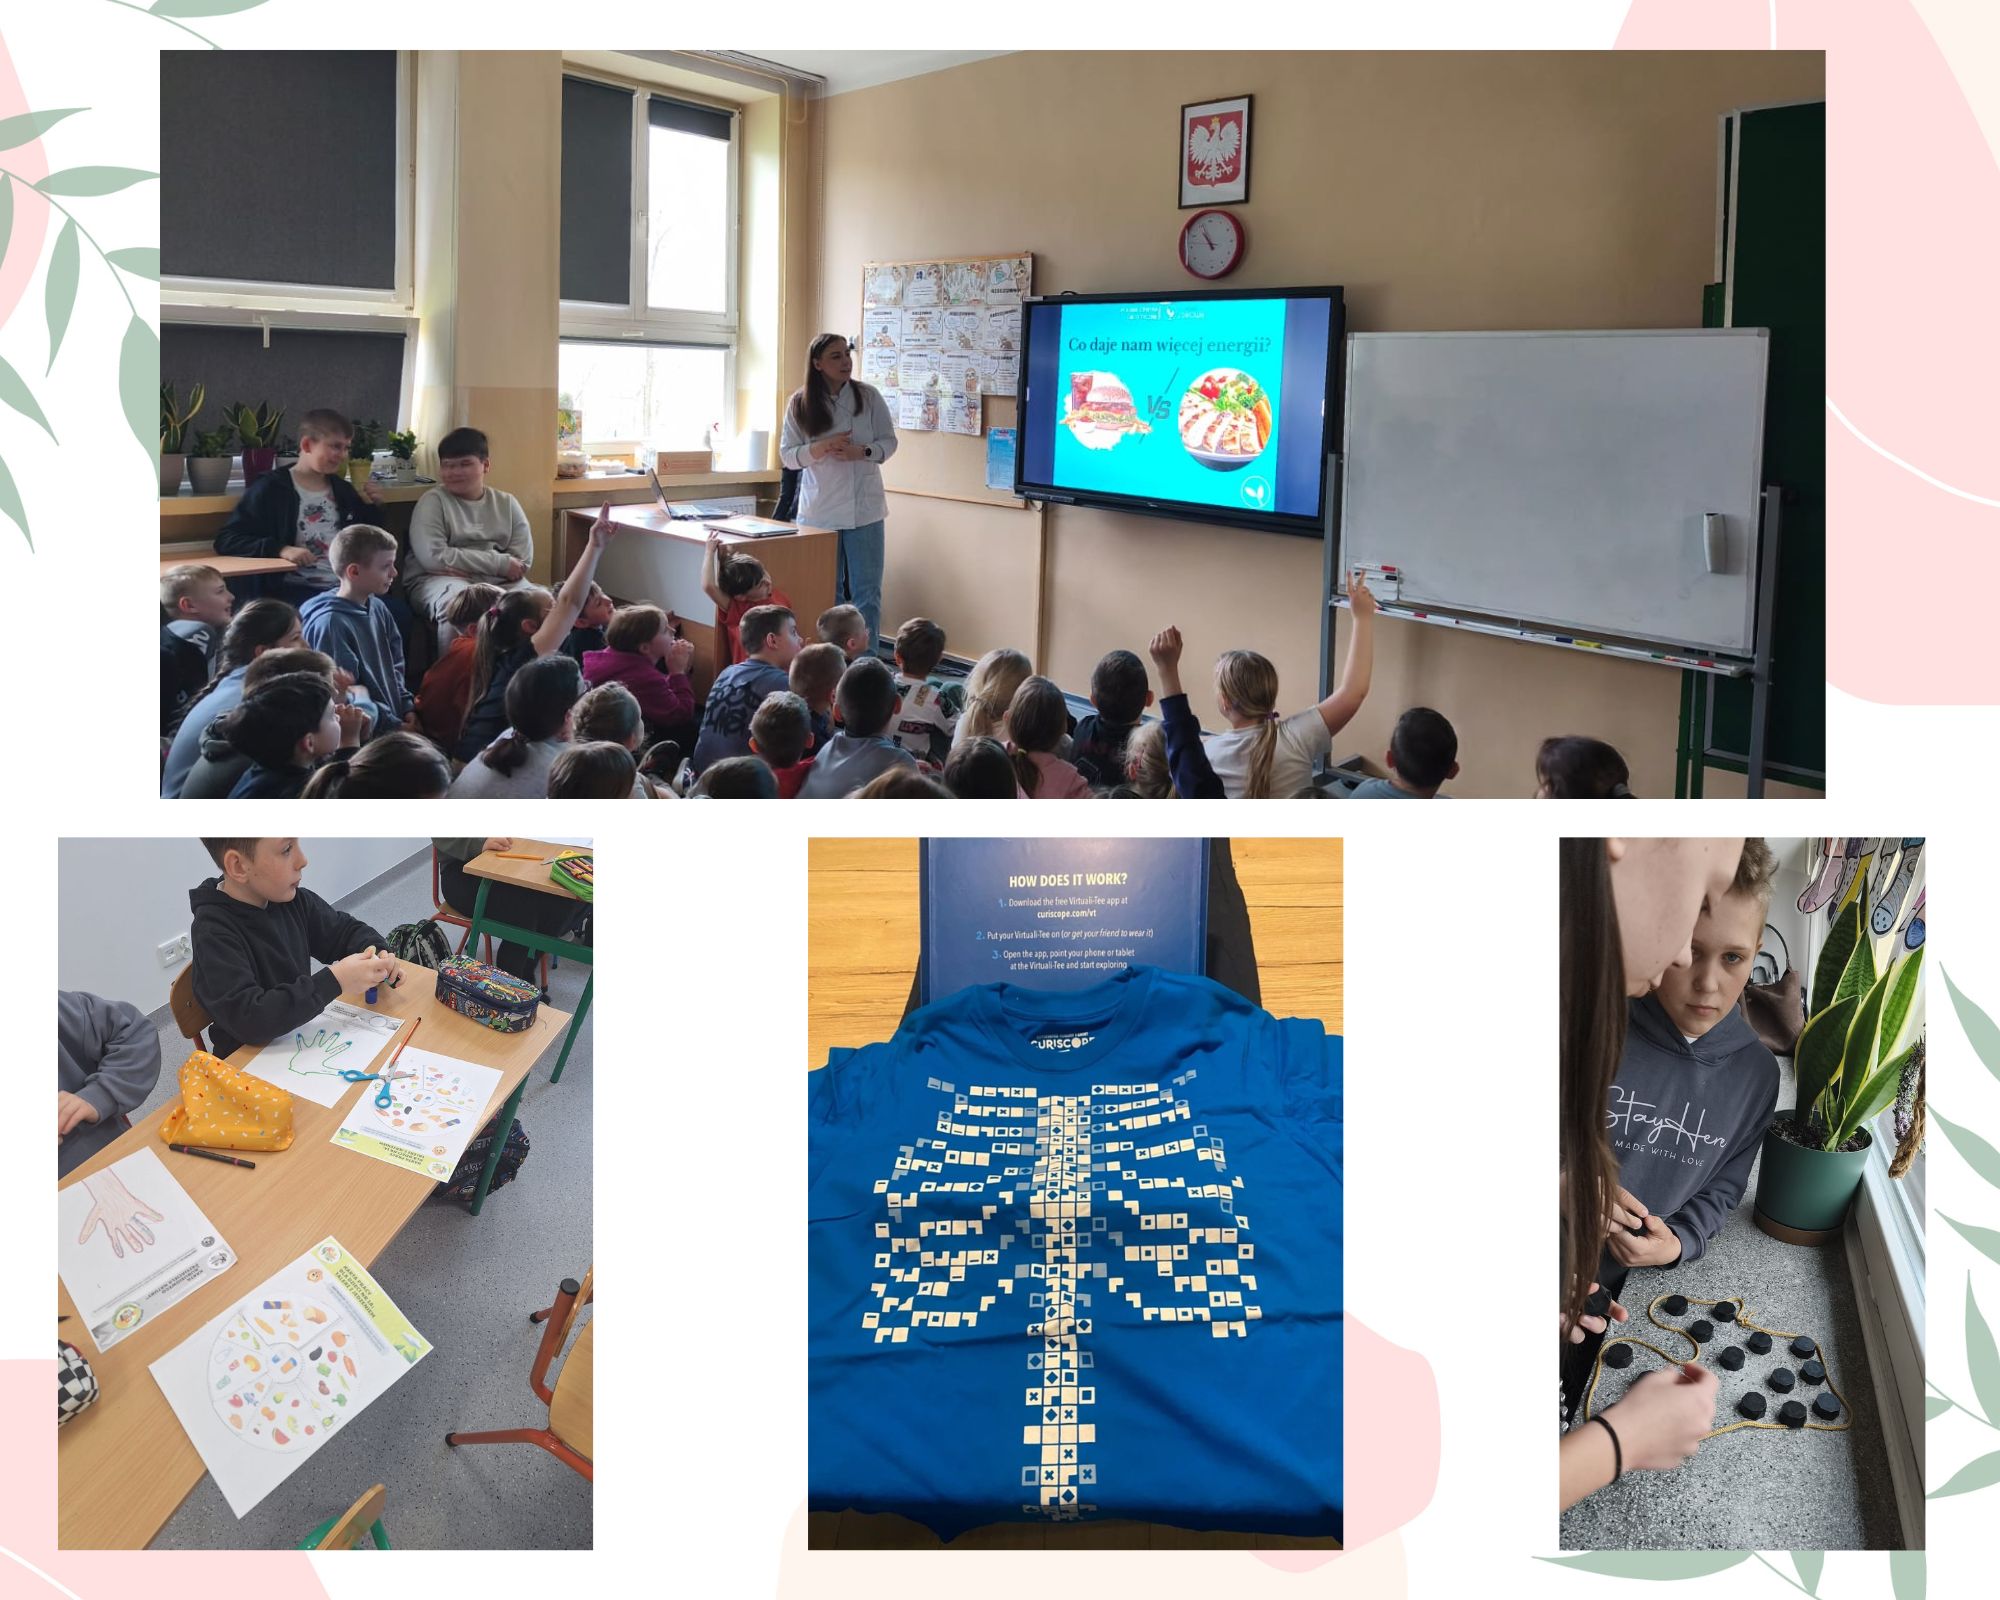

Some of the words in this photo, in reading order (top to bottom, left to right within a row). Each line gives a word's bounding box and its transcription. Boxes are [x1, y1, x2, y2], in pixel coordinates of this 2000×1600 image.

[1068, 337, 1086, 351] Co
[1090, 336, 1117, 355] daje
[1121, 341, 1152, 351] nam
[1156, 336, 1203, 356] więcej
[1207, 336, 1272, 357] energii?
[1147, 394, 1171, 420] VS
[1009, 875, 1037, 888] HOW
[1040, 874, 1070, 887] DOES
[1072, 873, 1083, 886] IT
[1086, 872, 1128, 886] WORK?
[1008, 898, 1042, 906] Download
[1043, 898, 1054, 906] the
[1055, 896, 1068, 906] free
[1069, 896, 1106, 905] Virtuali-Tee
[1106, 898, 1120, 906] app
[1121, 896, 1128, 904] at
[1037, 908, 1096, 920] curiscope.com/vt
[976, 931, 985, 940] 2.
[988, 931, 998, 940] Put
[999, 932, 1014, 942] your
[1014, 930, 1050, 940] Virtuali-Tee
[1062, 930, 1071, 939] (or
[1072, 930, 1082, 940] get
[1083, 931, 1100, 940] your
[1099, 928, 1120, 938] friend
[1146, 928, 1154, 938] it)
[992, 950, 1002, 960] 3.
[1003, 950, 1020, 960] Open
[1034, 952, 1048, 960] app,
[1050, 950, 1067, 960] point
[1068, 950, 1084, 960] your
[1084, 948, 1106, 958] phone
[1116, 948, 1135, 957] tablet
[1018, 962, 1028, 970] the
[1030, 961, 1065, 970] Virtuali-Tee
[1066, 961, 1078, 969] and
[1080, 960, 1095, 969] start
[1096, 960, 1128, 971] exploring
[1614, 1140, 1646, 1152] MADE
[1651, 1146, 1677, 1160] WITH
[1682, 1155, 1704, 1166] LOVE
